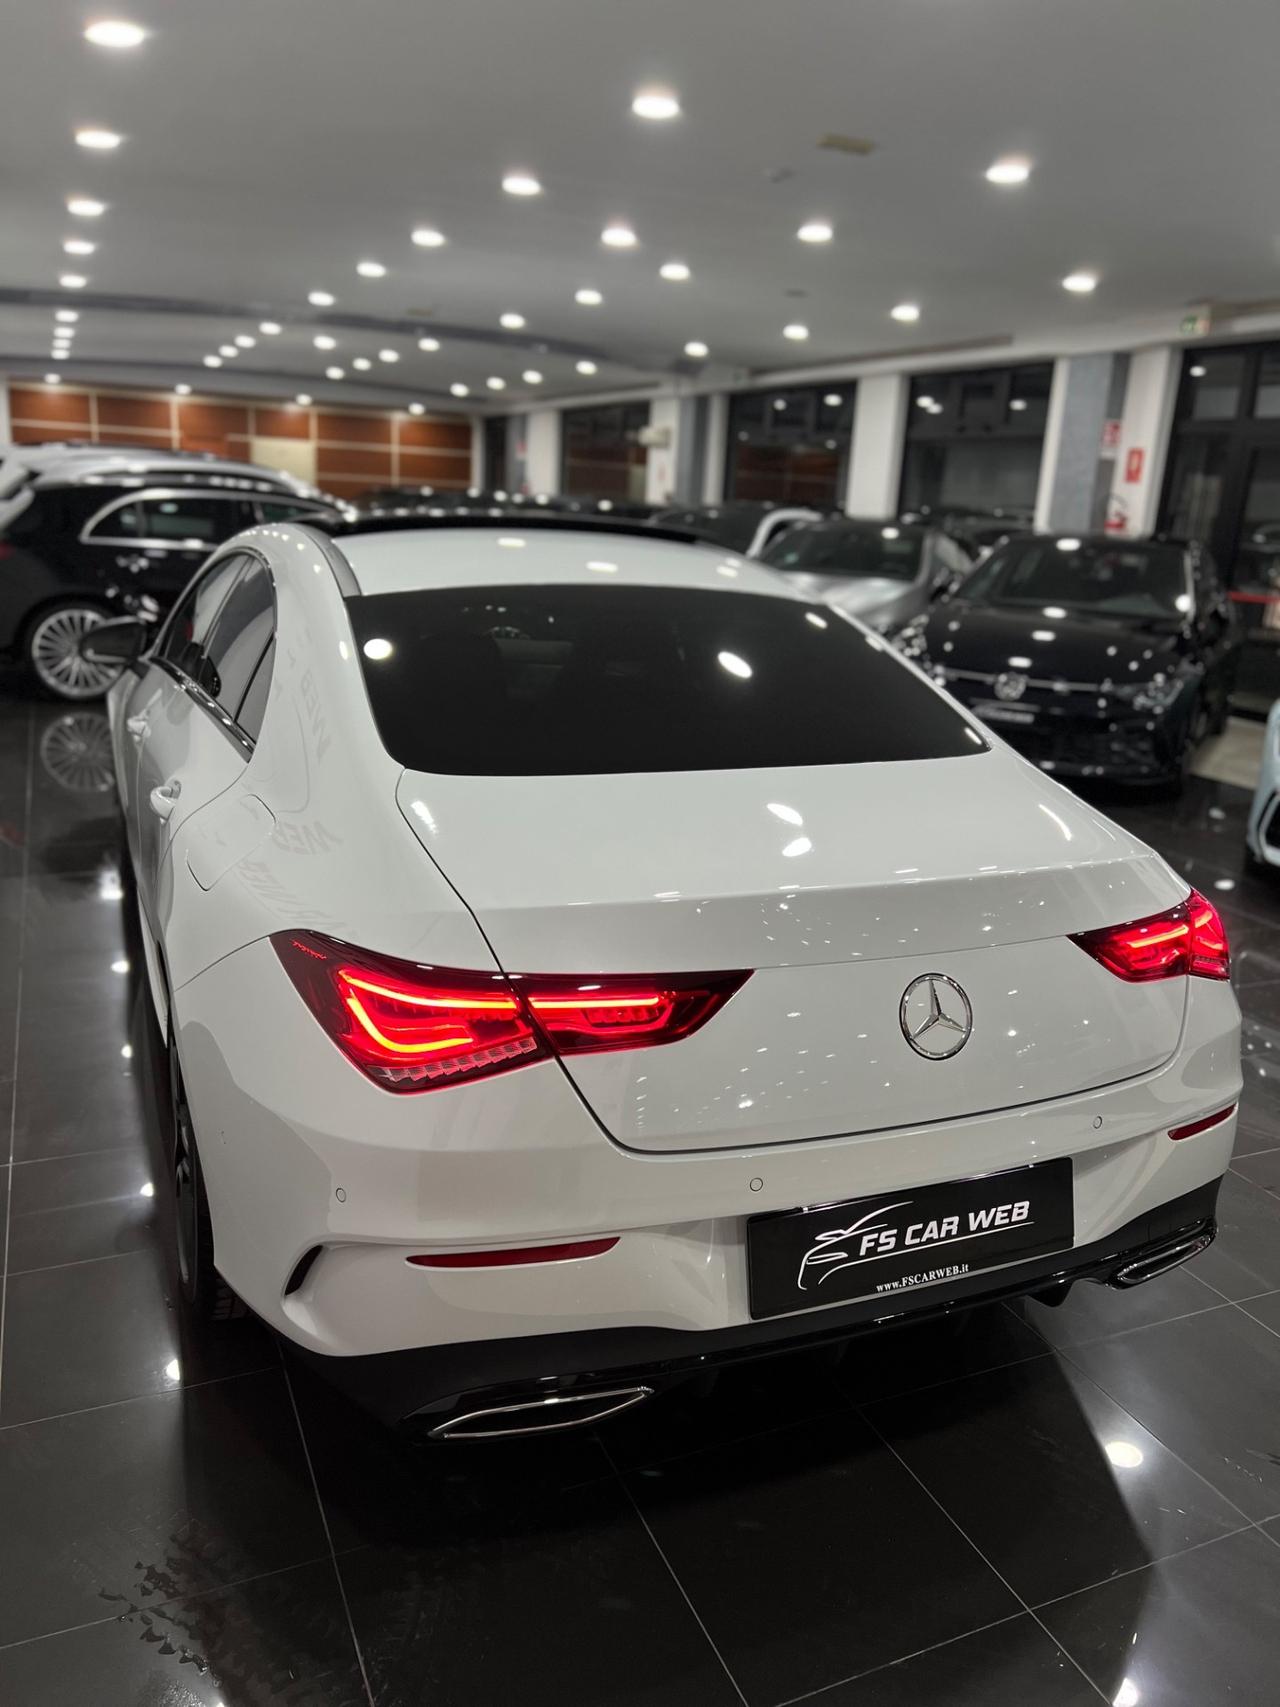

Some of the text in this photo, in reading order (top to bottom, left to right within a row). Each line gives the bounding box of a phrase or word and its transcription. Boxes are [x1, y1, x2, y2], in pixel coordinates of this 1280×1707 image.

[859, 1200, 1030, 1256] FS CAR WEB
[876, 1263, 969, 1292] www.FSCARWEB.it
